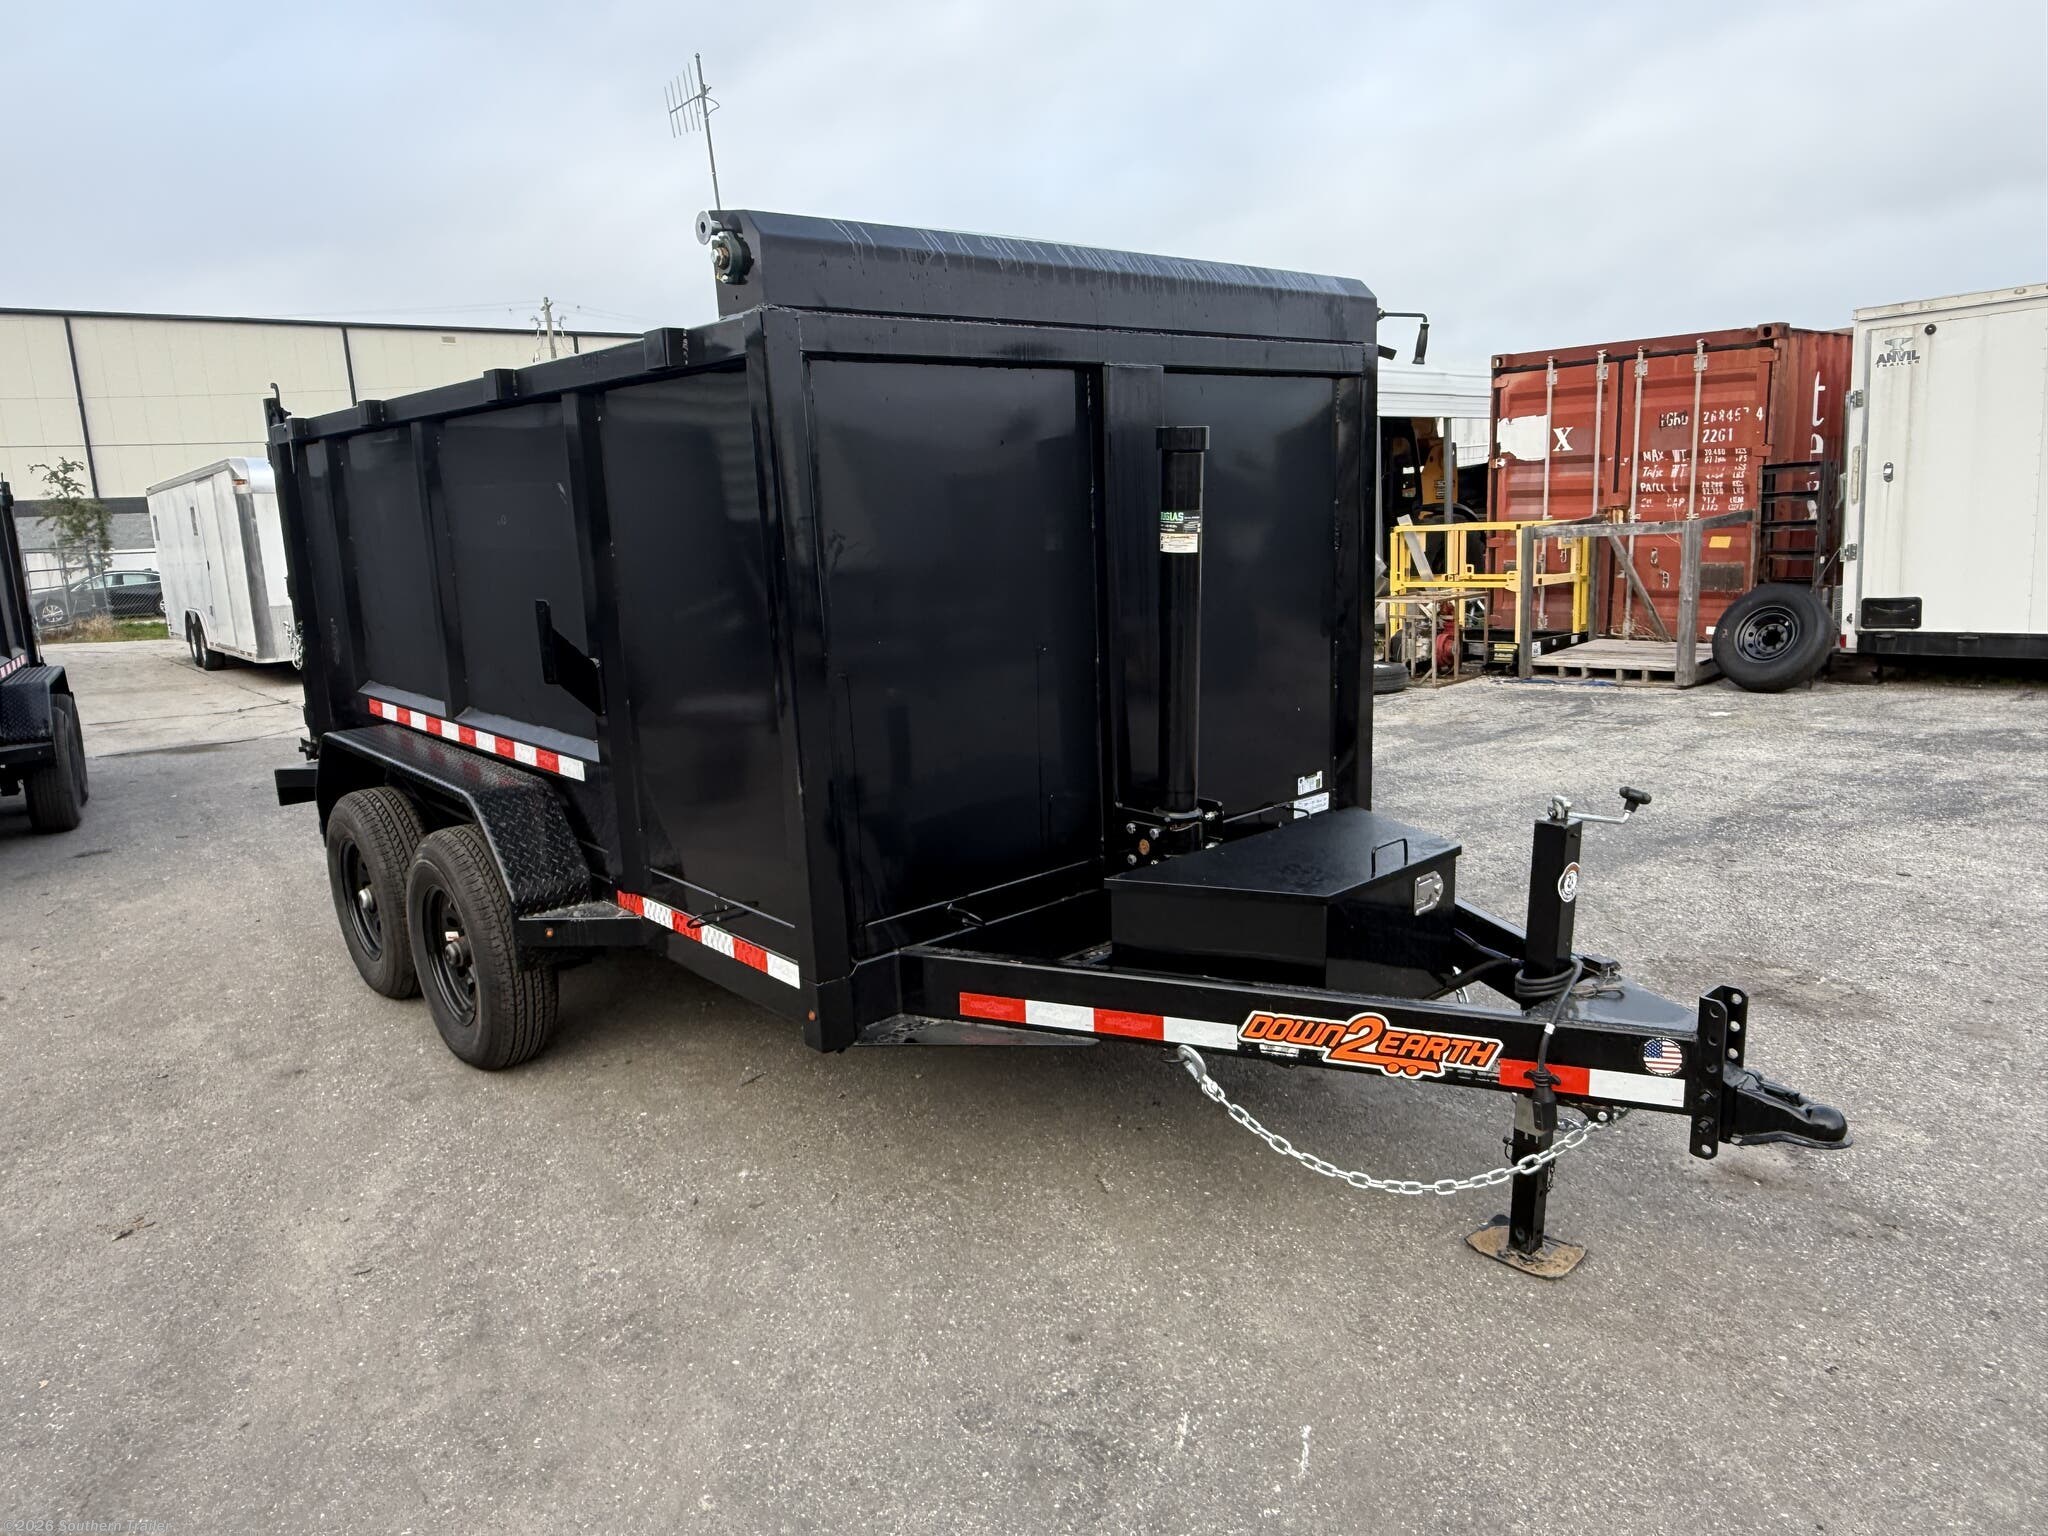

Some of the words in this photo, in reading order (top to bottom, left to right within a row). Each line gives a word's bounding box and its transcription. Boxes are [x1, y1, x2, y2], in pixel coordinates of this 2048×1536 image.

[1876, 349, 1920, 364] ANVIL
[1552, 426, 1574, 452] X
[1242, 1014, 1500, 1070] DOWN2EARTH
